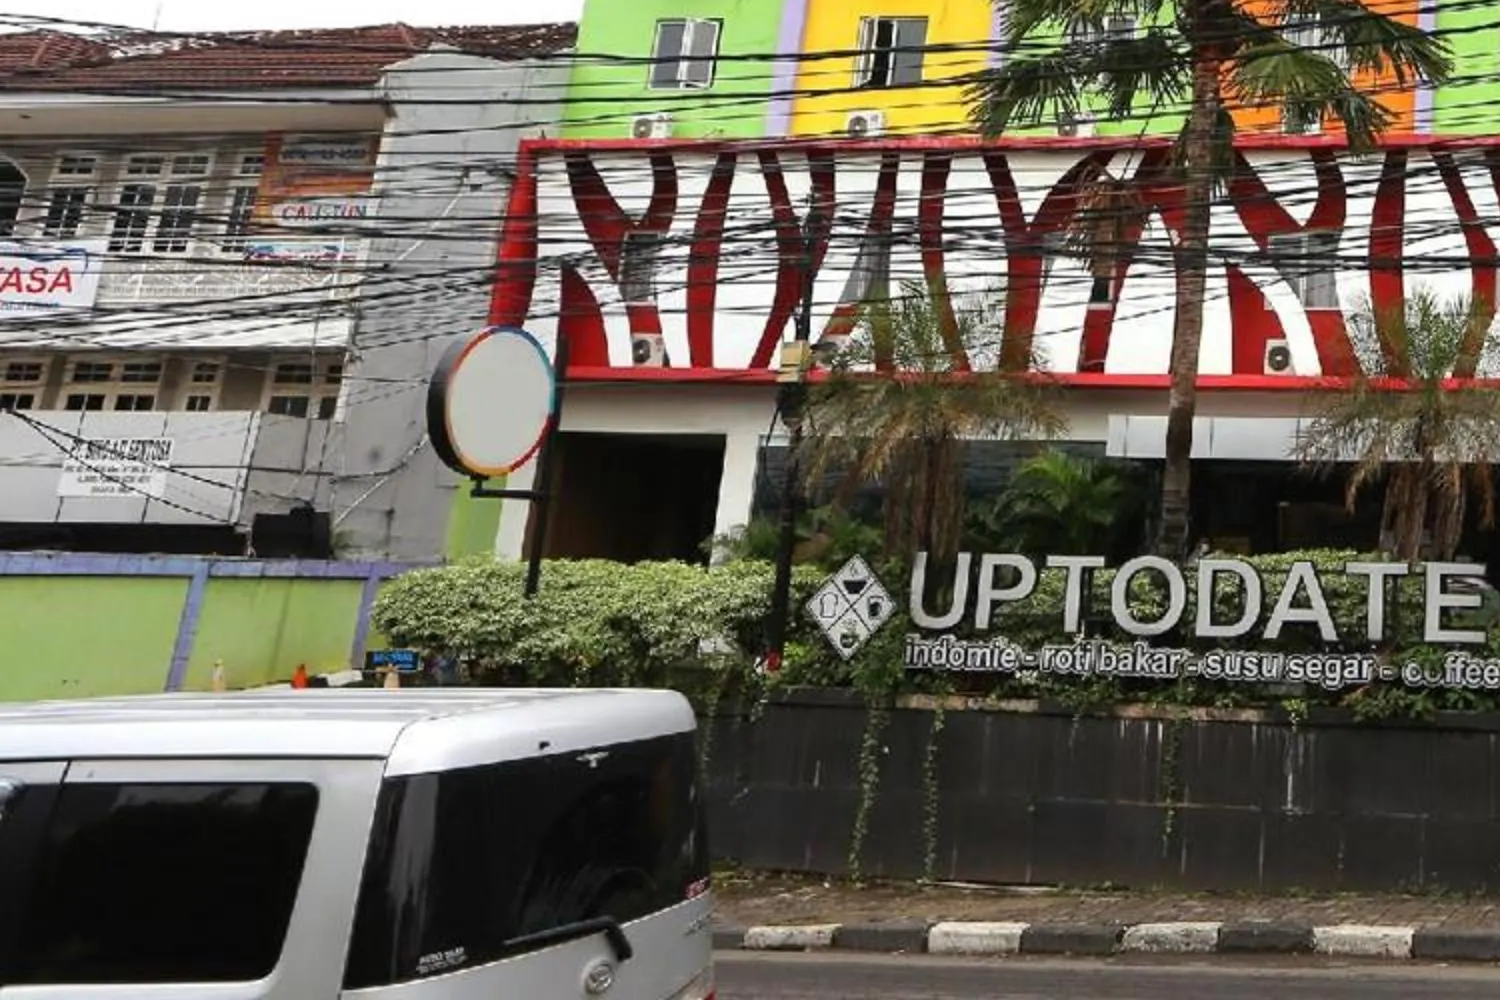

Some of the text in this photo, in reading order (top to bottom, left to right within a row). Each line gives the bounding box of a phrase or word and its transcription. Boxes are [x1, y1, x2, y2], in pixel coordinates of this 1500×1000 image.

[0, 266, 74, 294] ASA
[909, 550, 1487, 644] UPTODATE
[904, 637, 1017, 670] indomie
[1042, 640, 1092, 673] roti
[1098, 642, 1182, 677] bakar
[1204, 654, 1279, 679] susu
[1288, 657, 1375, 687] segar
